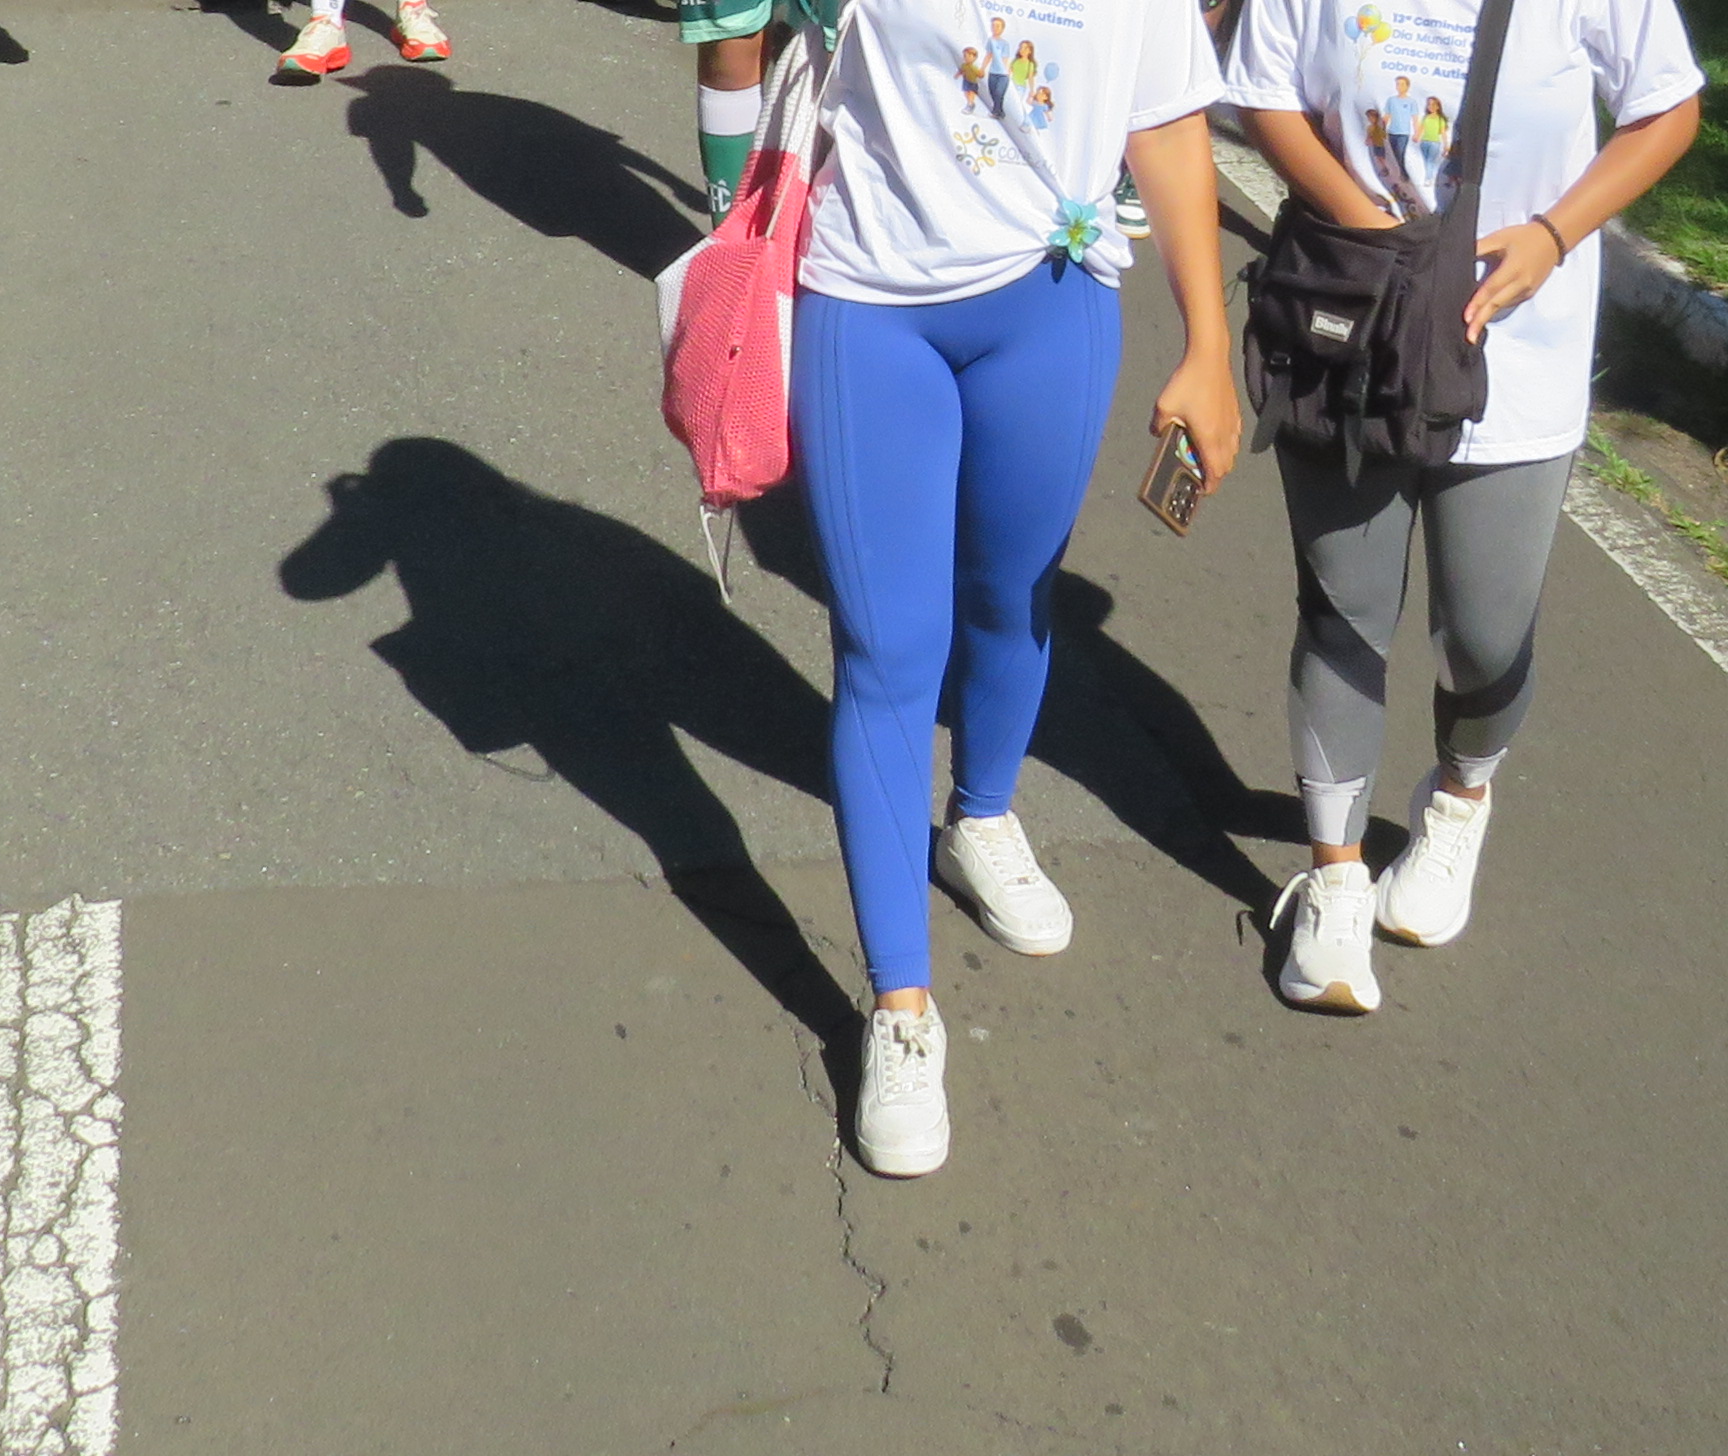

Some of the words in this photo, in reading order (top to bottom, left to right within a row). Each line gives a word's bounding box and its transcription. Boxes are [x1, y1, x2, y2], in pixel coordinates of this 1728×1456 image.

[979, 0, 1013, 15] sobre
[1016, 8, 1025, 17] o
[1028, 8, 1084, 29] Autismo
[1392, 29, 1412, 40] Dia
[1416, 33, 1467, 47] Mundial
[1381, 61, 1417, 73] sobre
[1420, 66, 1429, 75] o
